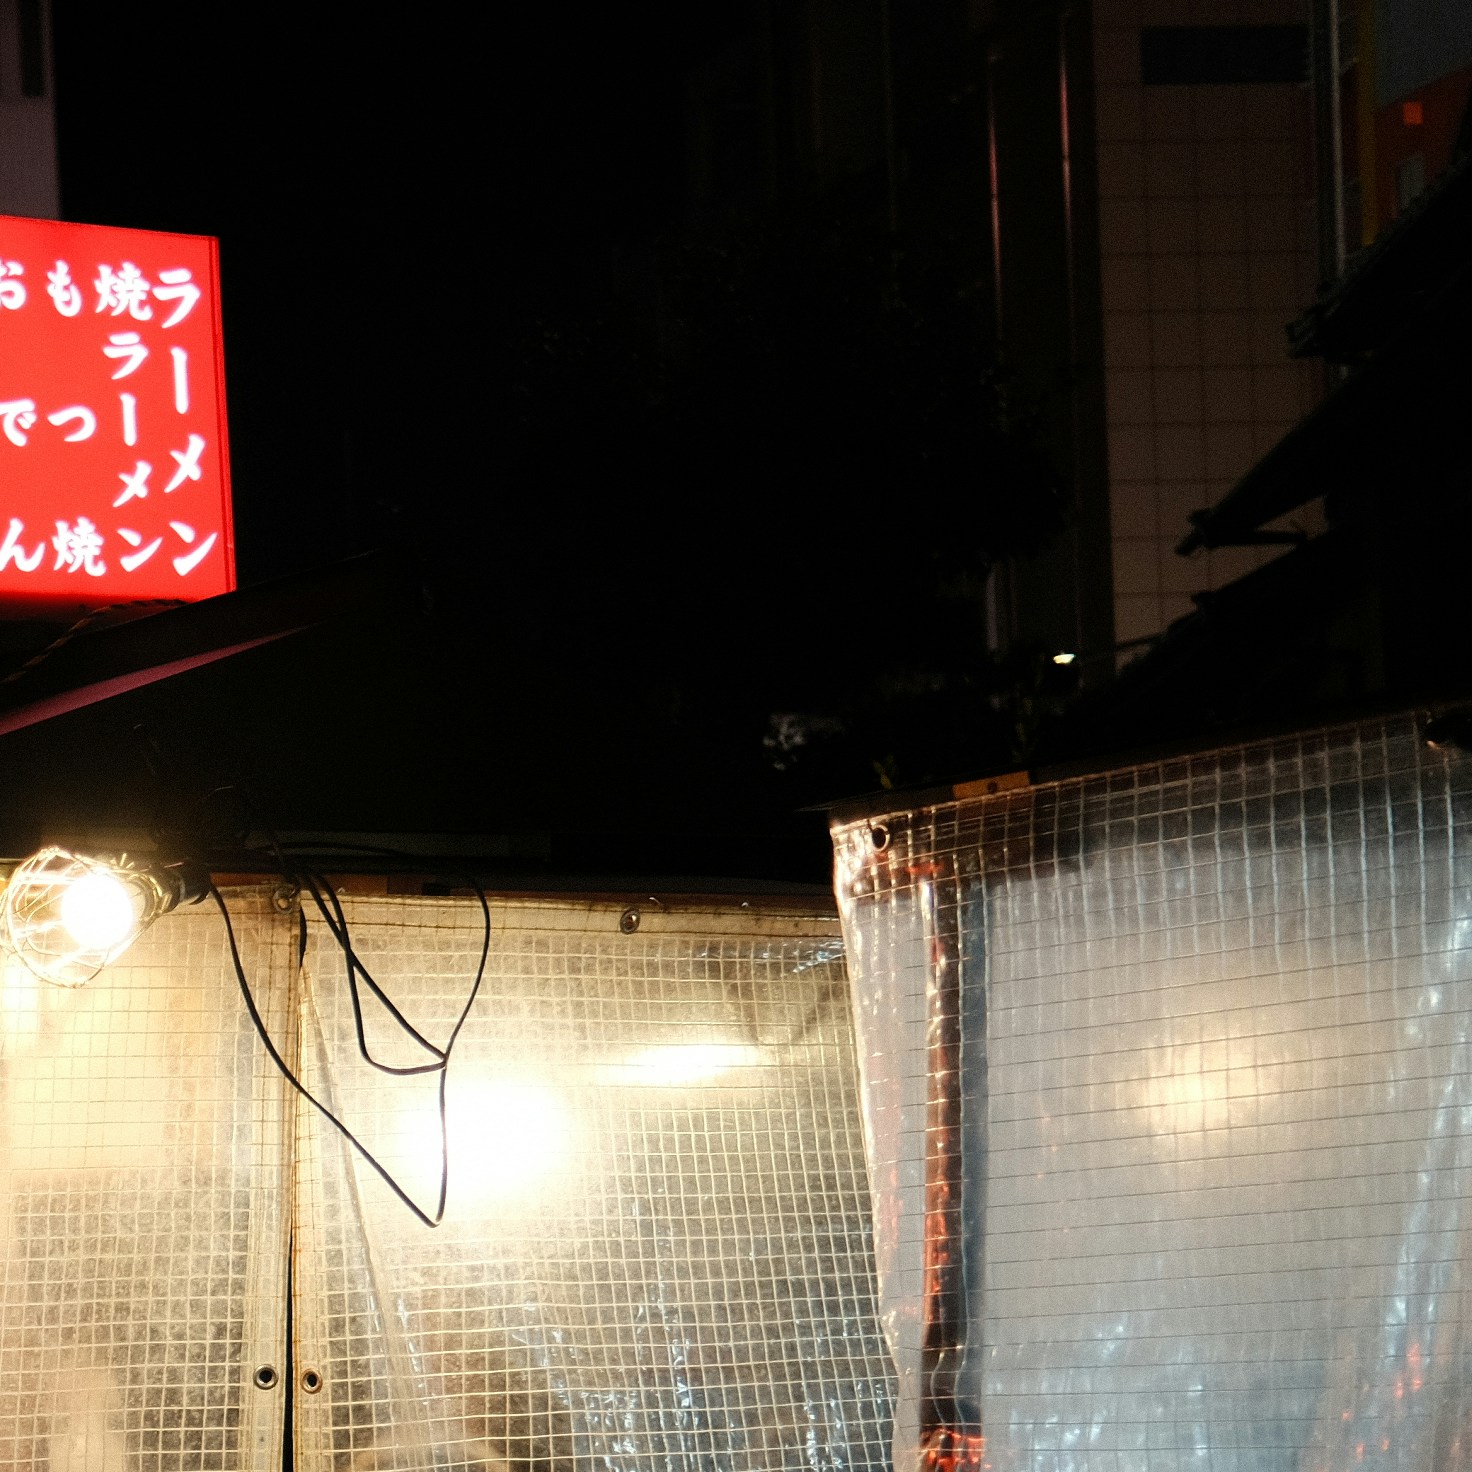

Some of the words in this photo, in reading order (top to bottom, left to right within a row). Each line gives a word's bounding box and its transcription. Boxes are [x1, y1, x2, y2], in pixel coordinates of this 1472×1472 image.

[47, 260, 107, 577] もつ焼
[94, 262, 163, 573] 焼ラーメン
[153, 268, 218, 577] ラーメン
